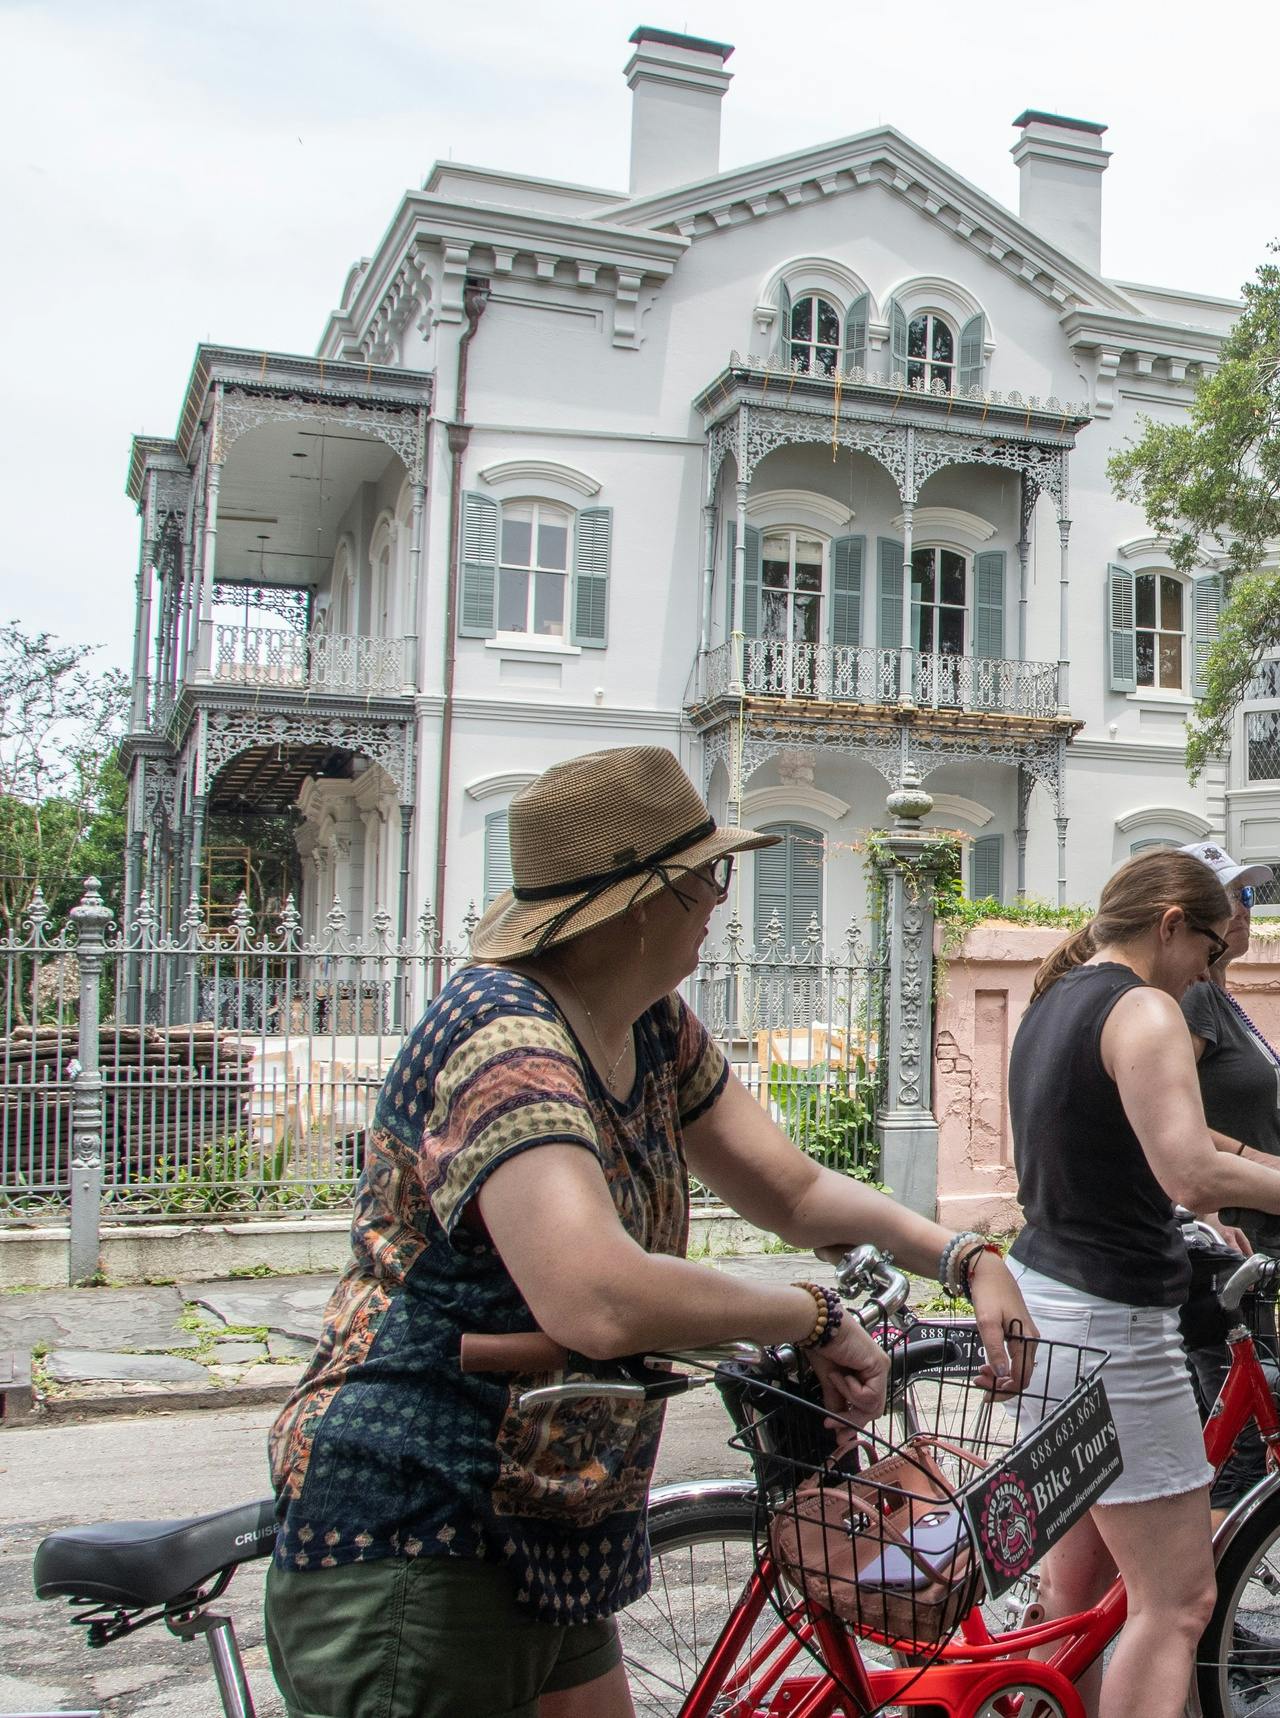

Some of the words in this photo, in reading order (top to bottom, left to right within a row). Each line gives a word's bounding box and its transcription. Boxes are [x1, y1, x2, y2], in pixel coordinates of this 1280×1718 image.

[1030, 1387, 1101, 1470] 888.683.8687
[1032, 1465, 1072, 1515] Bike
[1071, 1420, 1116, 1474] Tours
[988, 1498, 997, 1538] PAVED
[995, 1483, 1028, 1509] PARADISE
[1046, 1456, 1119, 1540] pavedparadisetoursnola.com
[1008, 1545, 1027, 1563] TOURS
